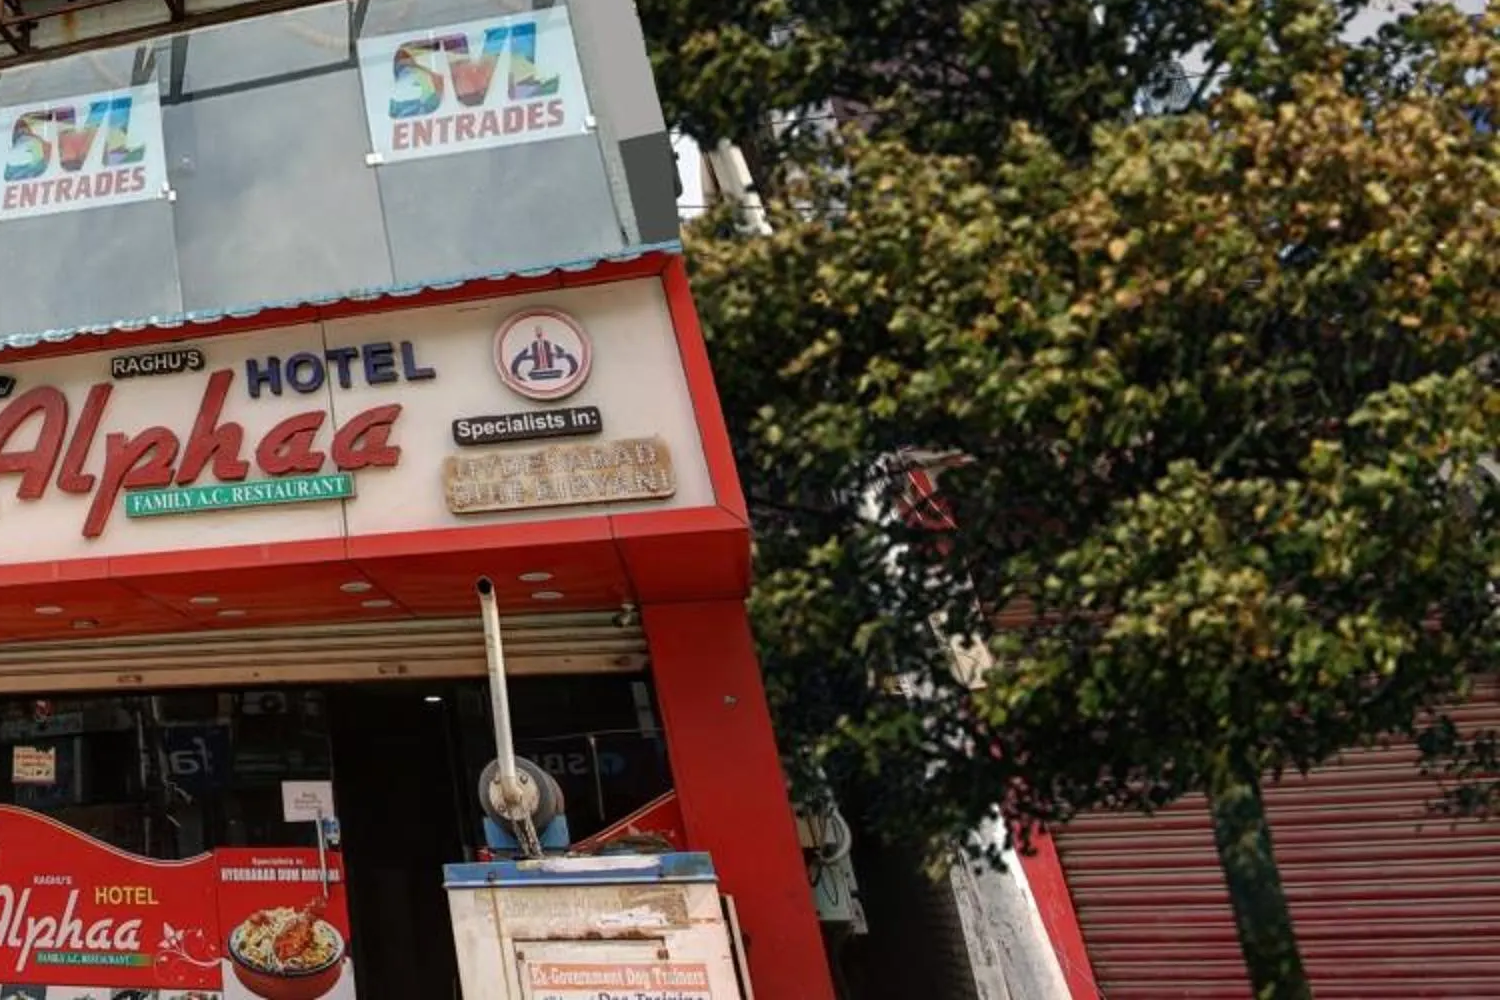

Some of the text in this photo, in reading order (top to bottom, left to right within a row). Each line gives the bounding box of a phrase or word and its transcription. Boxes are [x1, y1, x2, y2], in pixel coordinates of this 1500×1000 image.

[389, 21, 561, 119] SVL
[4, 96, 146, 181] SVL
[391, 99, 564, 151] ENTRADES
[3, 166, 146, 210] ENTRADES
[112, 341, 436, 398] RAGHU'S HOTEL
[456, 408, 598, 441] Specialists in:
[132, 494, 193, 512] FAMILY
[232, 477, 346, 502] RESTAURANT
[95, 886, 159, 905] HOTEL
